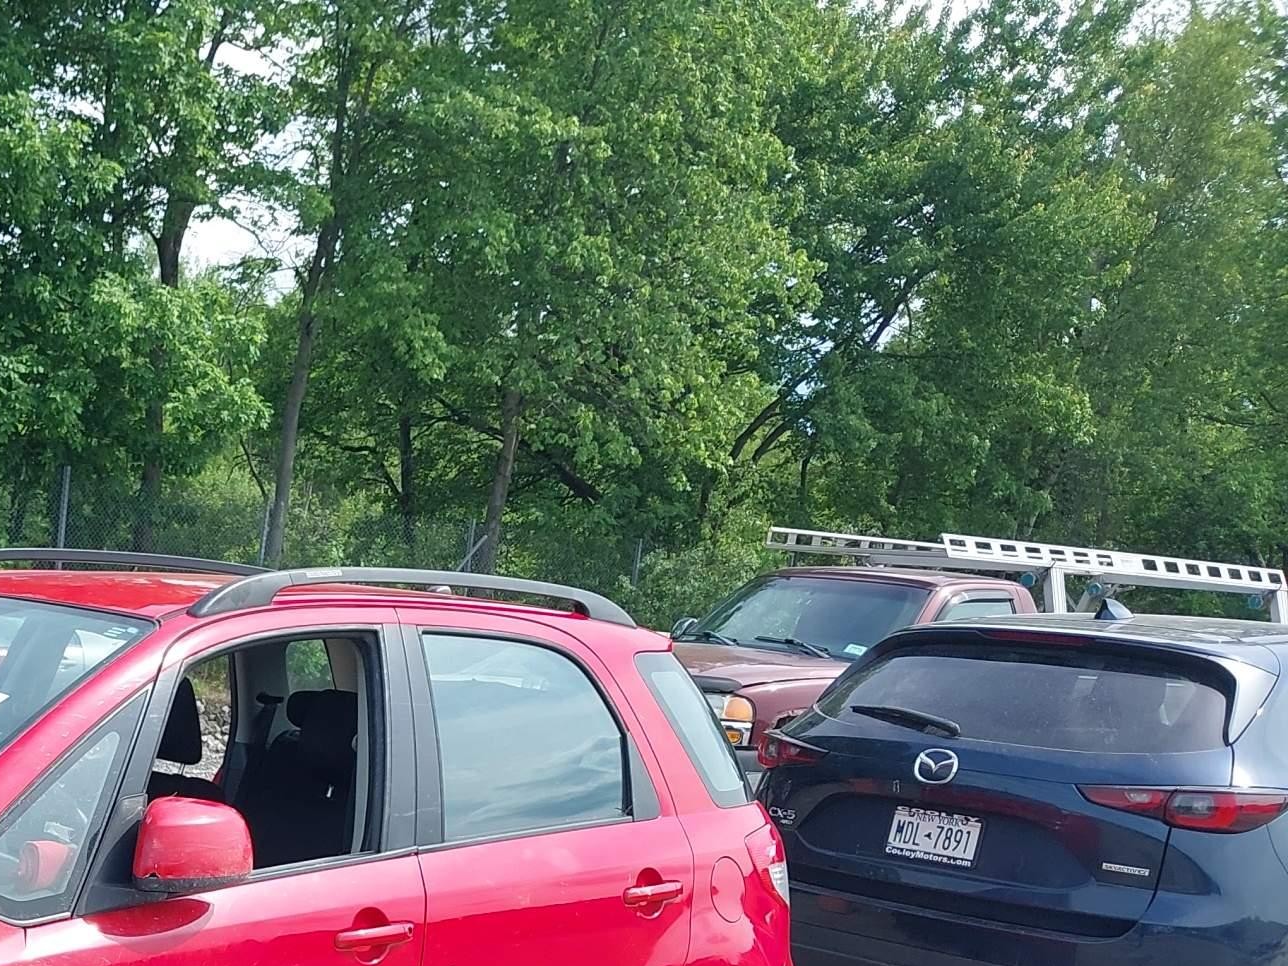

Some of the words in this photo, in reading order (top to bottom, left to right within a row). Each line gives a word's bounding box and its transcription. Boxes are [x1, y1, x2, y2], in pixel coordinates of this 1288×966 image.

[769, 806, 796, 820] CX-5
[916, 813, 935, 823] NEW
[938, 816, 960, 827] YORK
[893, 820, 920, 846] MDL
[933, 825, 972, 855] 7891
